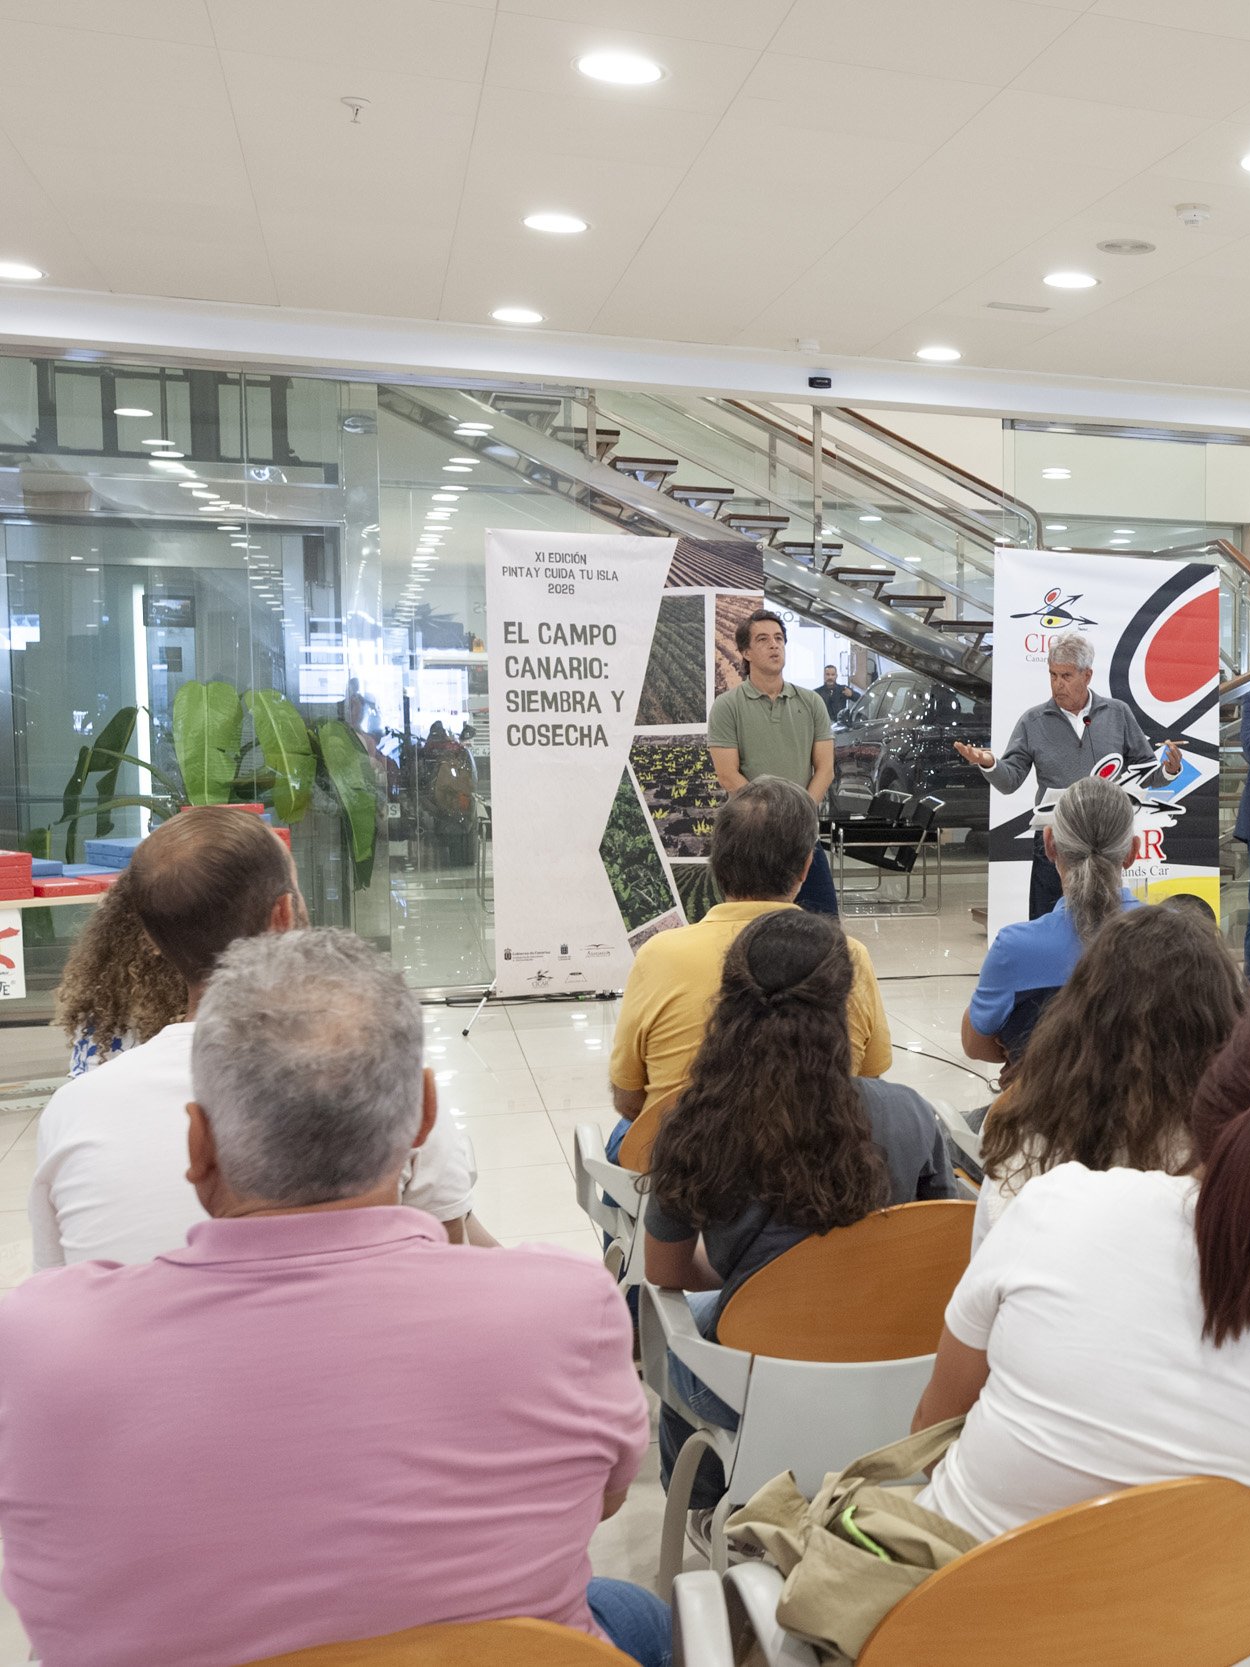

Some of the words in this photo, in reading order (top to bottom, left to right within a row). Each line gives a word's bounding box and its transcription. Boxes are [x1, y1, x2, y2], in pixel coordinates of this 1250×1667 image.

[535, 552, 545, 562] XI
[548, 552, 587, 565] EDICIÓN
[502, 566, 533, 578] PINTA
[544, 567, 575, 580] CUIDA
[579, 569, 593, 580] TU
[597, 569, 619, 581] ISLA
[548, 583, 575, 595] 2026
[504, 621, 529, 644] EL
[538, 622, 617, 646] CAMPO
[505, 655, 609, 680] CANARIO:
[505, 690, 602, 714] SIEMBRA
[611, 690, 625, 713] Y
[506, 723, 609, 748] COSECHA
[1122, 866, 1147, 877] ands
[1150, 865, 1170, 877] Car
